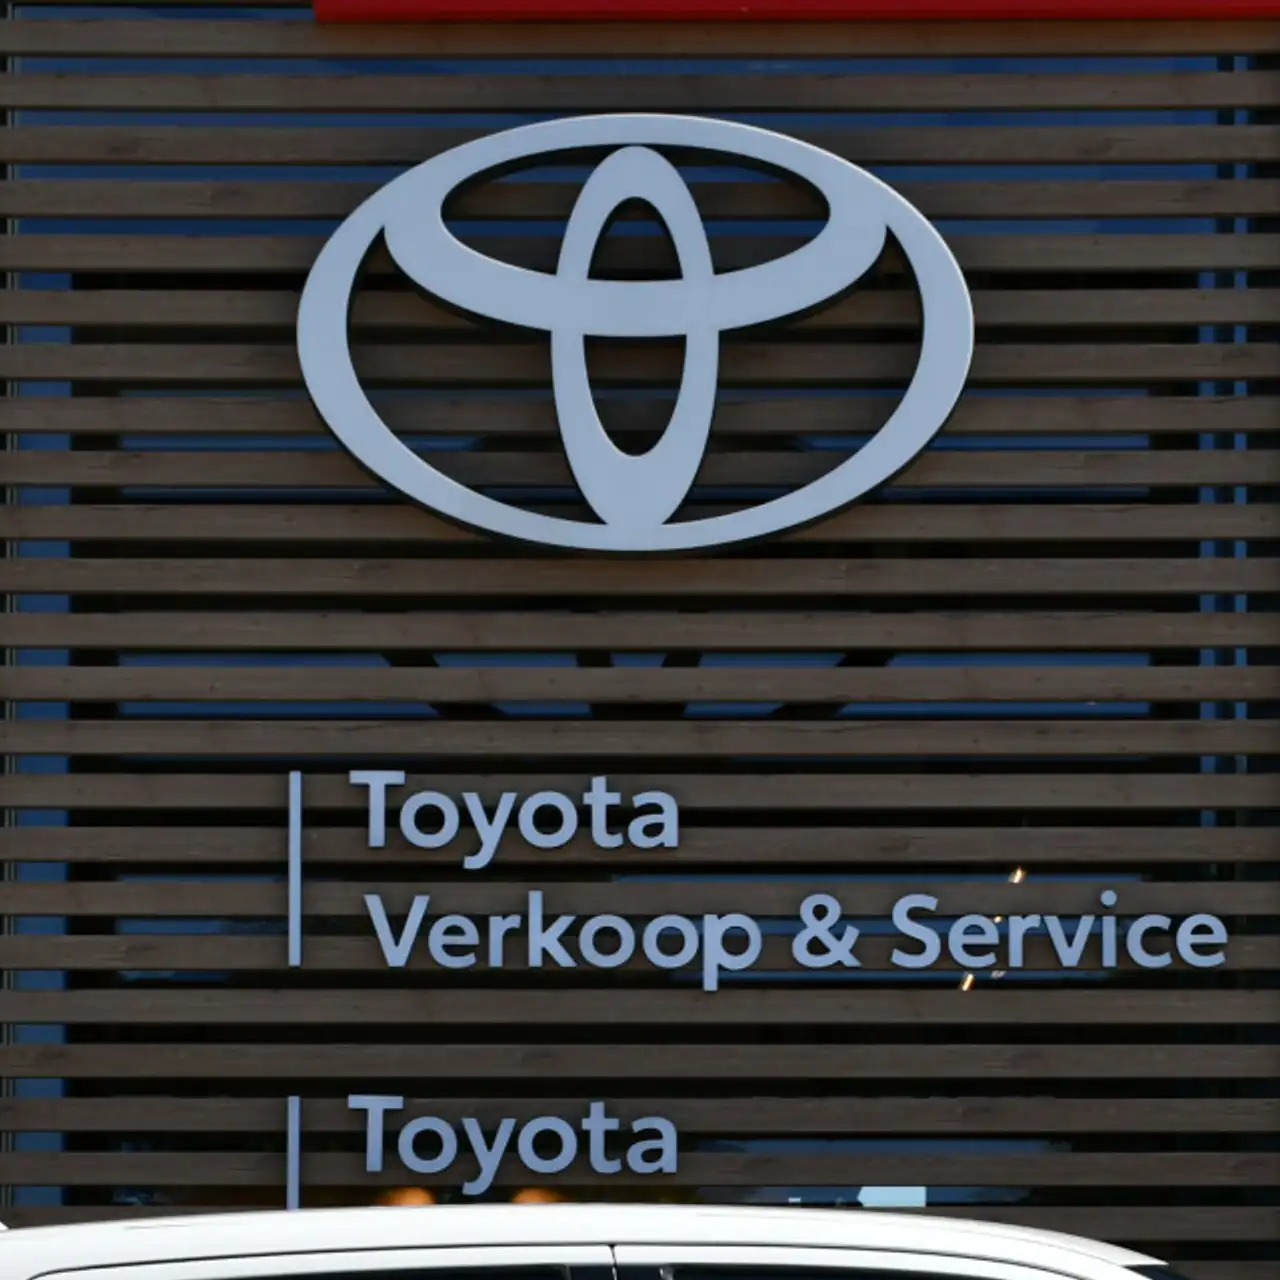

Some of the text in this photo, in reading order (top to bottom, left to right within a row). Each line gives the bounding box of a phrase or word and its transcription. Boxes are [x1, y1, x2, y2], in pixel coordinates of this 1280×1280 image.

[349, 770, 680, 869] Toyota
[364, 890, 1228, 991] Verkoop & Service
[347, 1094, 678, 1195] Toyota
